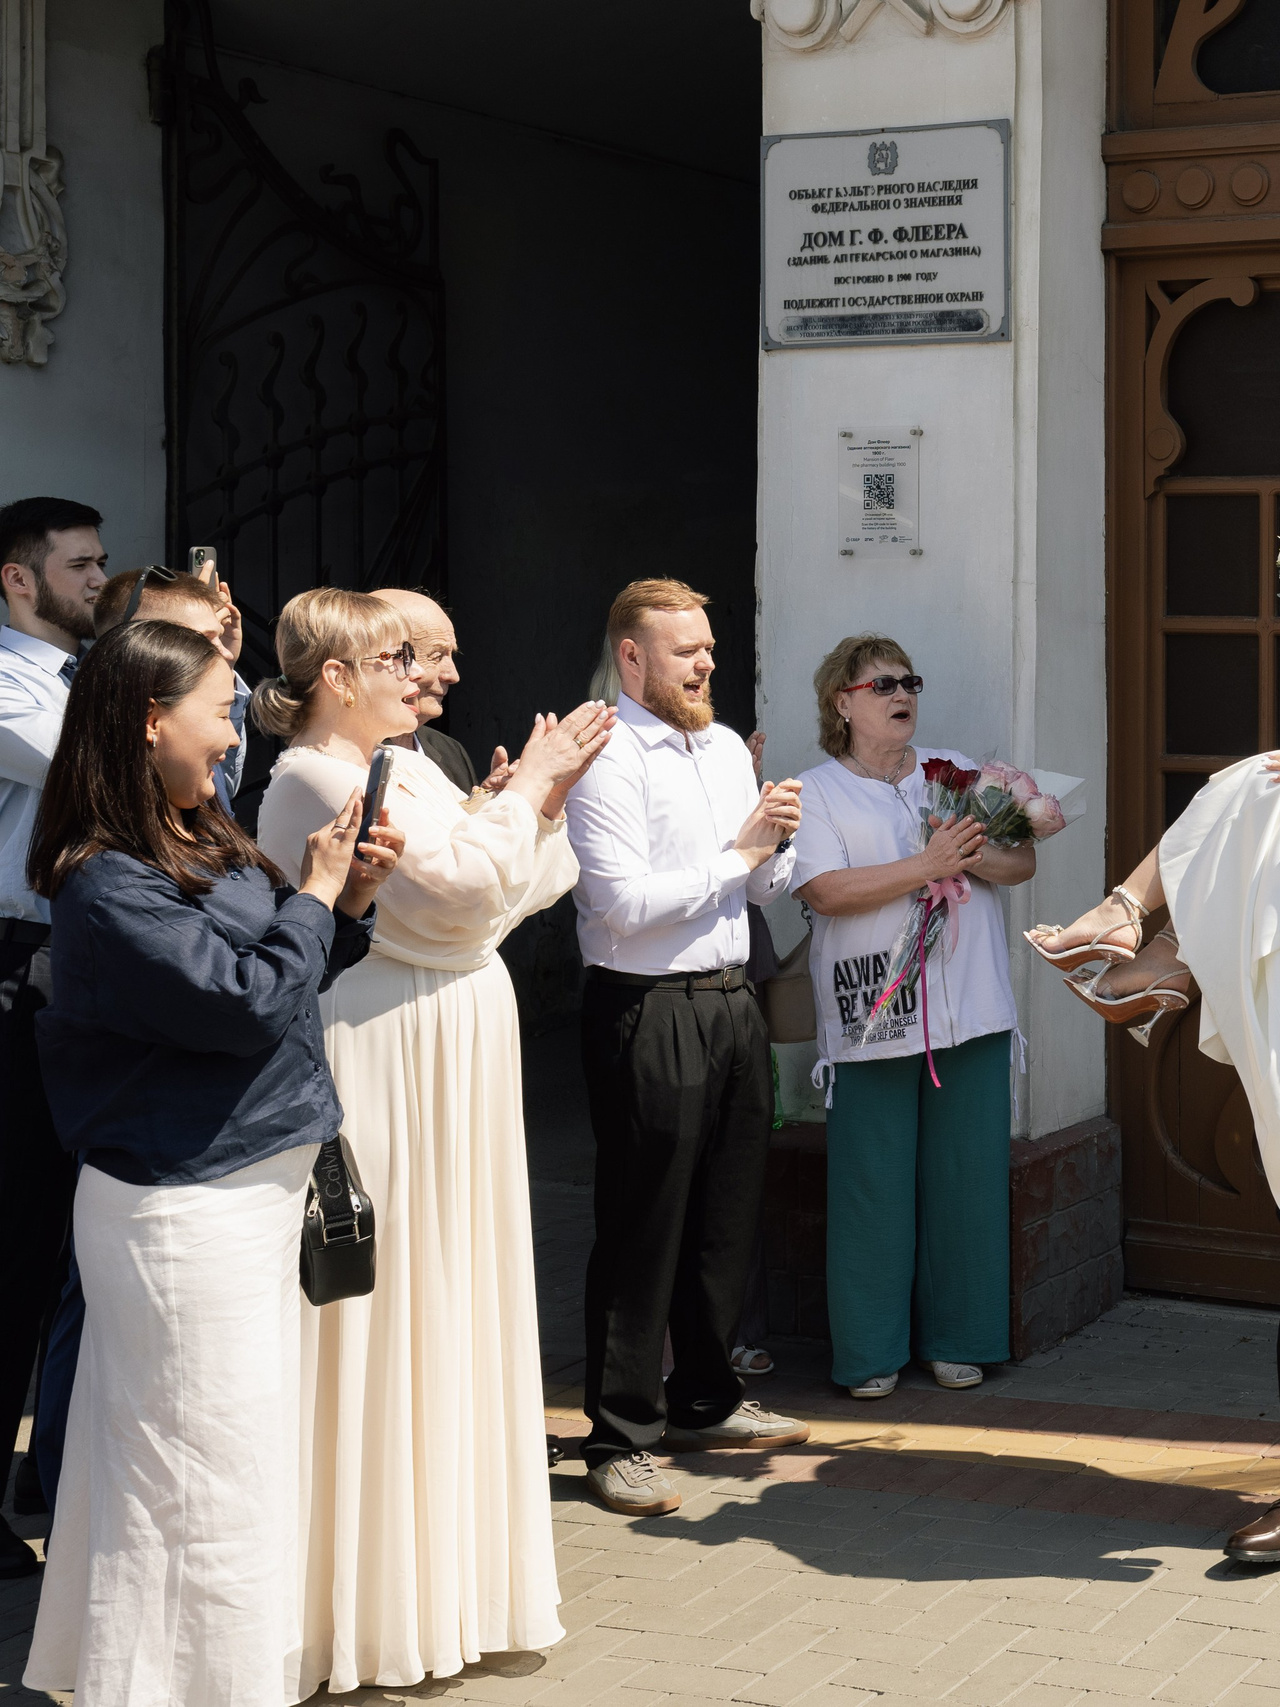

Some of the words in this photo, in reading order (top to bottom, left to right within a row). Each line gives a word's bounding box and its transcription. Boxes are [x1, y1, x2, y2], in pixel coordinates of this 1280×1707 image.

[789, 187, 833, 200] ОБЪЕКТ
[835, 182, 915, 198] КУЛЬТУРНОГО
[917, 179, 978, 193] НАСЛЕДИЯ
[811, 199, 901, 215] ФЕДЕРАЛЬНОГО
[903, 194, 963, 209] ЗНАЧЕНИЯ
[800, 230, 845, 252] ДОМ
[849, 229, 863, 246] Г.
[867, 228, 888, 245] Ф.
[892, 222, 969, 243] ФЛЕЕРА
[787, 254, 830, 267] (ЗДАНИЕ
[833, 249, 918, 264] АПТЕКАРСКОГО
[920, 246, 982, 258] МАГАЗИНА)
[834, 274, 884, 285] ПОСТРОЕНО
[887, 274, 893, 282] В
[916, 272, 938, 282] ГОДУ
[783, 297, 840, 310] ПОДЛЕЖИТ
[833, 950, 890, 993] ALWA
[836, 992, 859, 1025] BE
[889, 1014, 918, 1028] ONESELF
[877, 1030, 888, 1041] SELF
[888, 1028, 907, 1039] CARE
